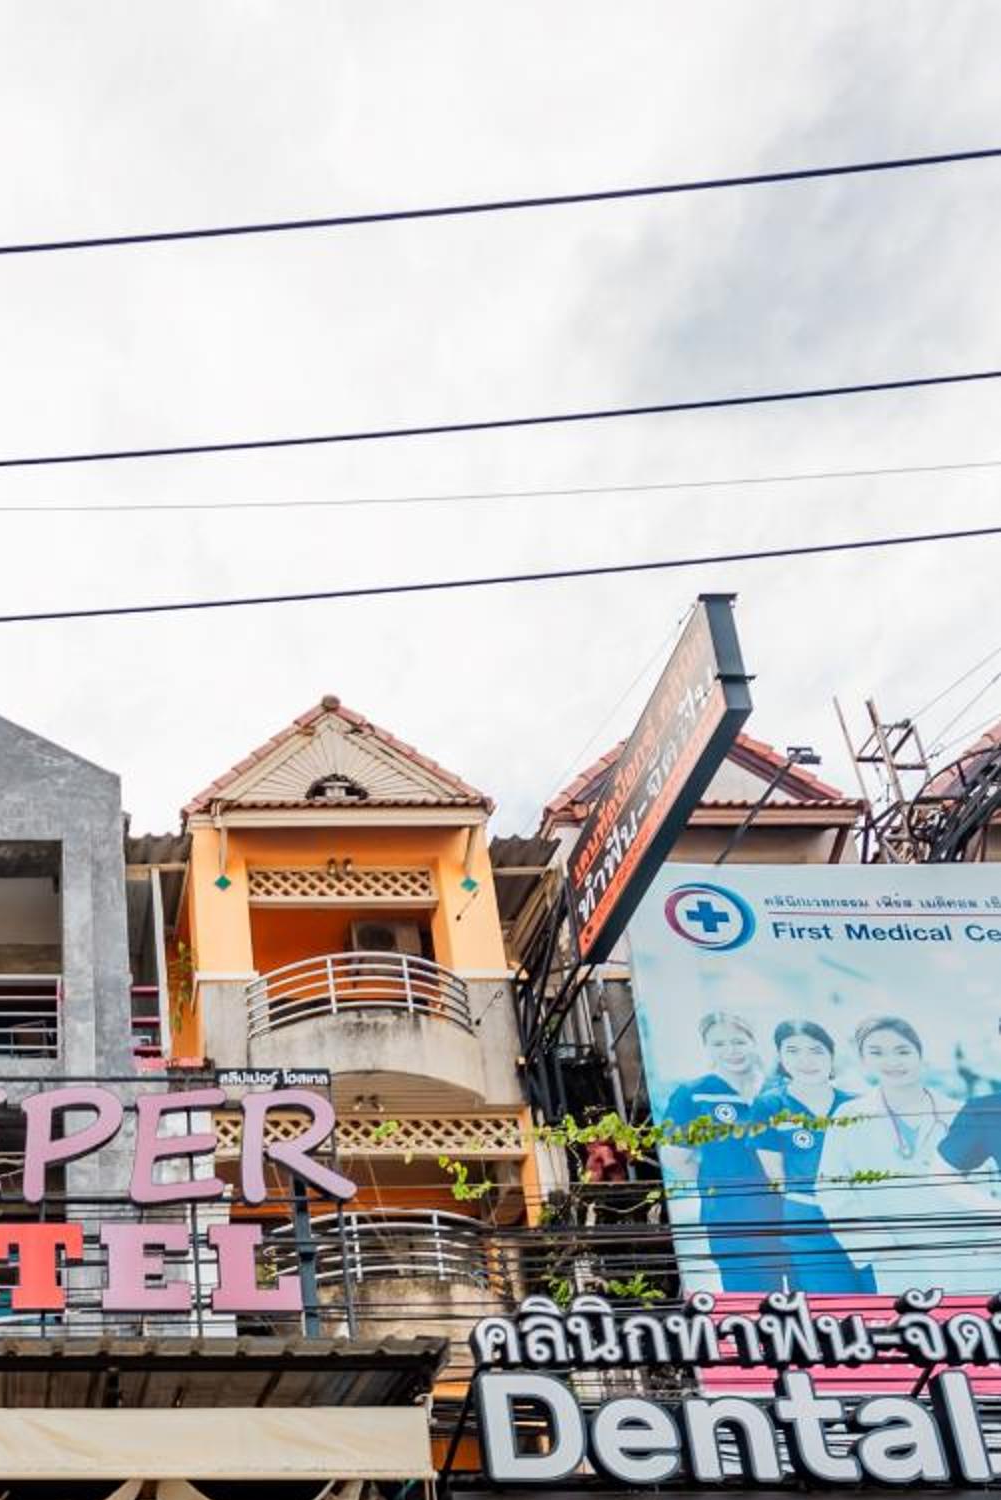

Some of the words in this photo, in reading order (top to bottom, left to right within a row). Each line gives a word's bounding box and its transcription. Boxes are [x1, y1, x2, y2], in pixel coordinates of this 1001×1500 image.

[772, 921, 833, 940] First
[844, 923, 952, 941] Medical
[474, 1287, 1001, 1363] คลินิกทำฟัน-จัด
[475, 1368, 995, 1485] Dental
